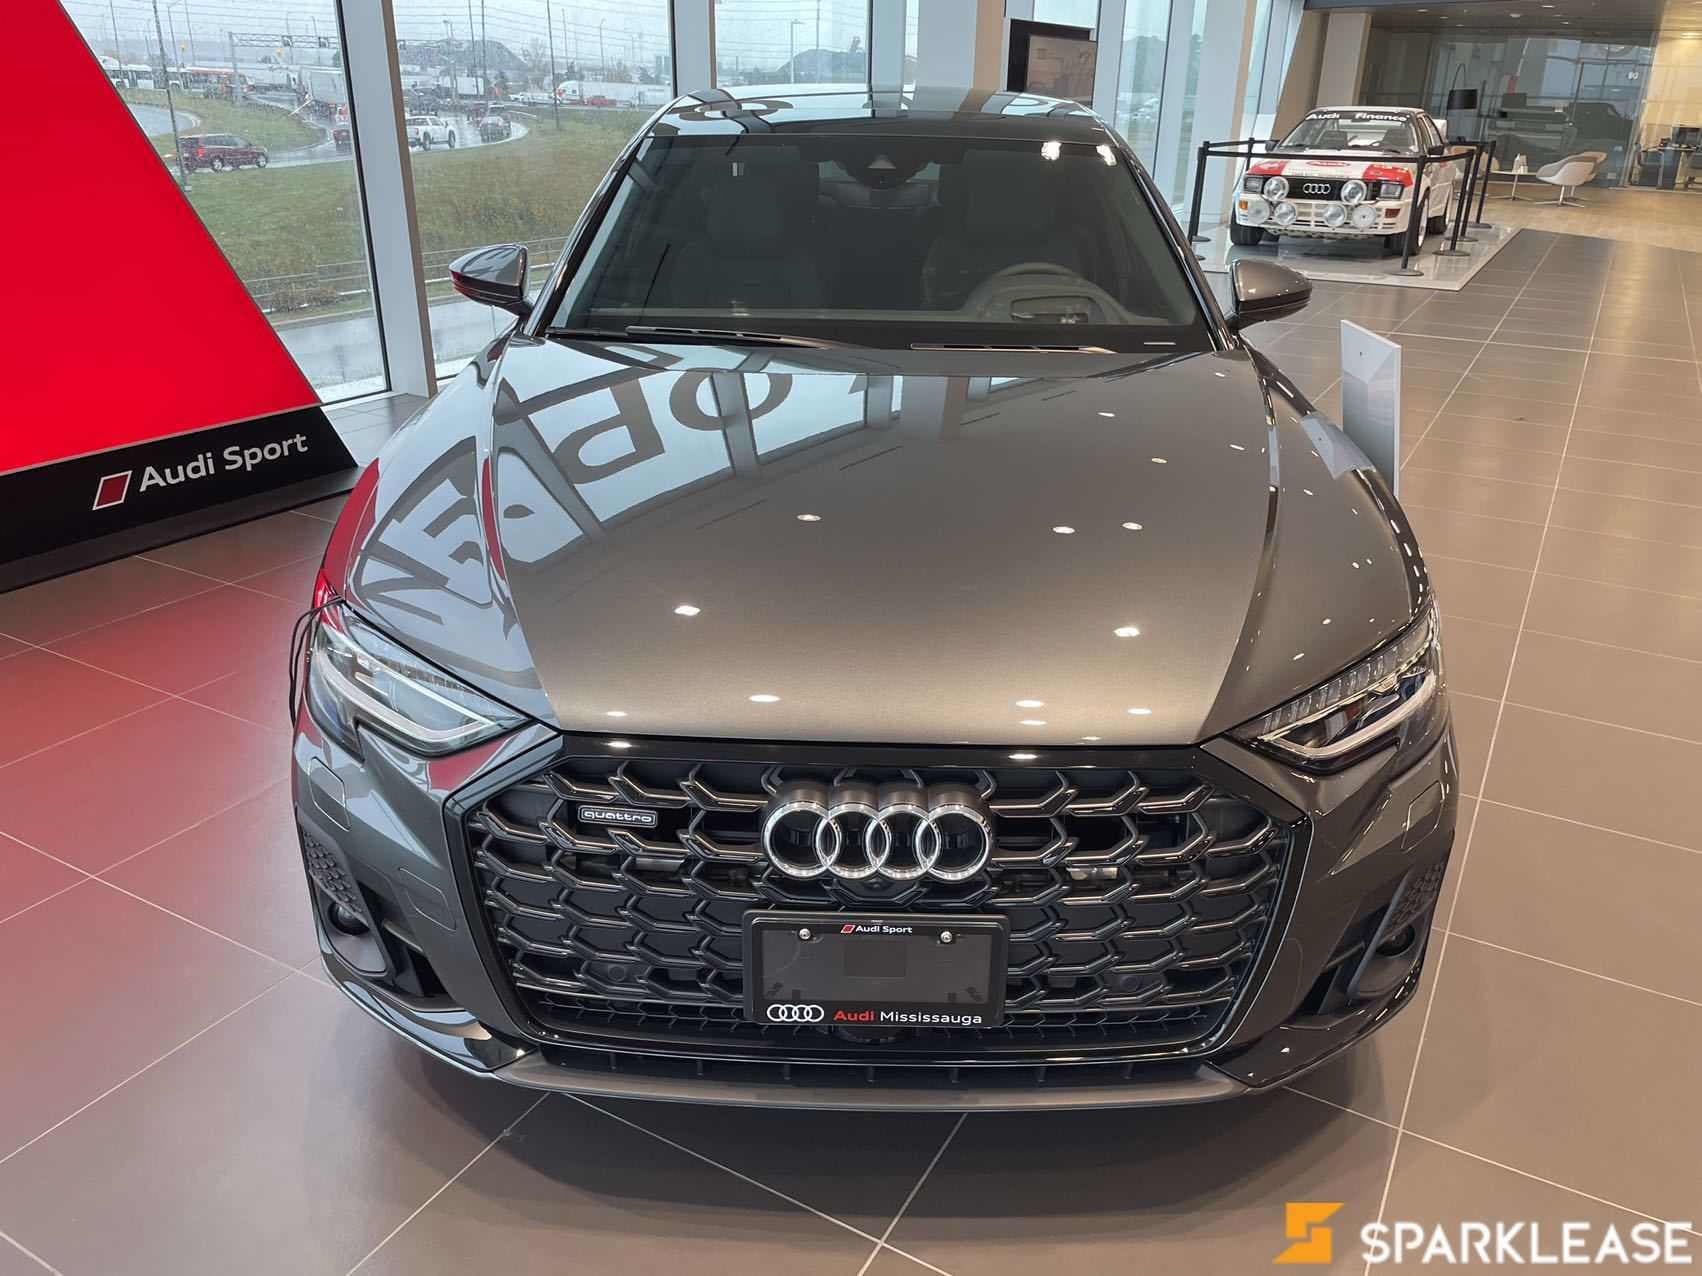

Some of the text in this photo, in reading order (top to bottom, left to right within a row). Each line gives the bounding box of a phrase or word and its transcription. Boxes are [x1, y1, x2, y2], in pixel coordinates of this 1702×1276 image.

[139, 433, 309, 492] Audi Sport
[582, 811, 653, 823] quattro
[856, 924, 913, 934] Audi Sport
[833, 1010, 983, 1026] Audi Mississauga
